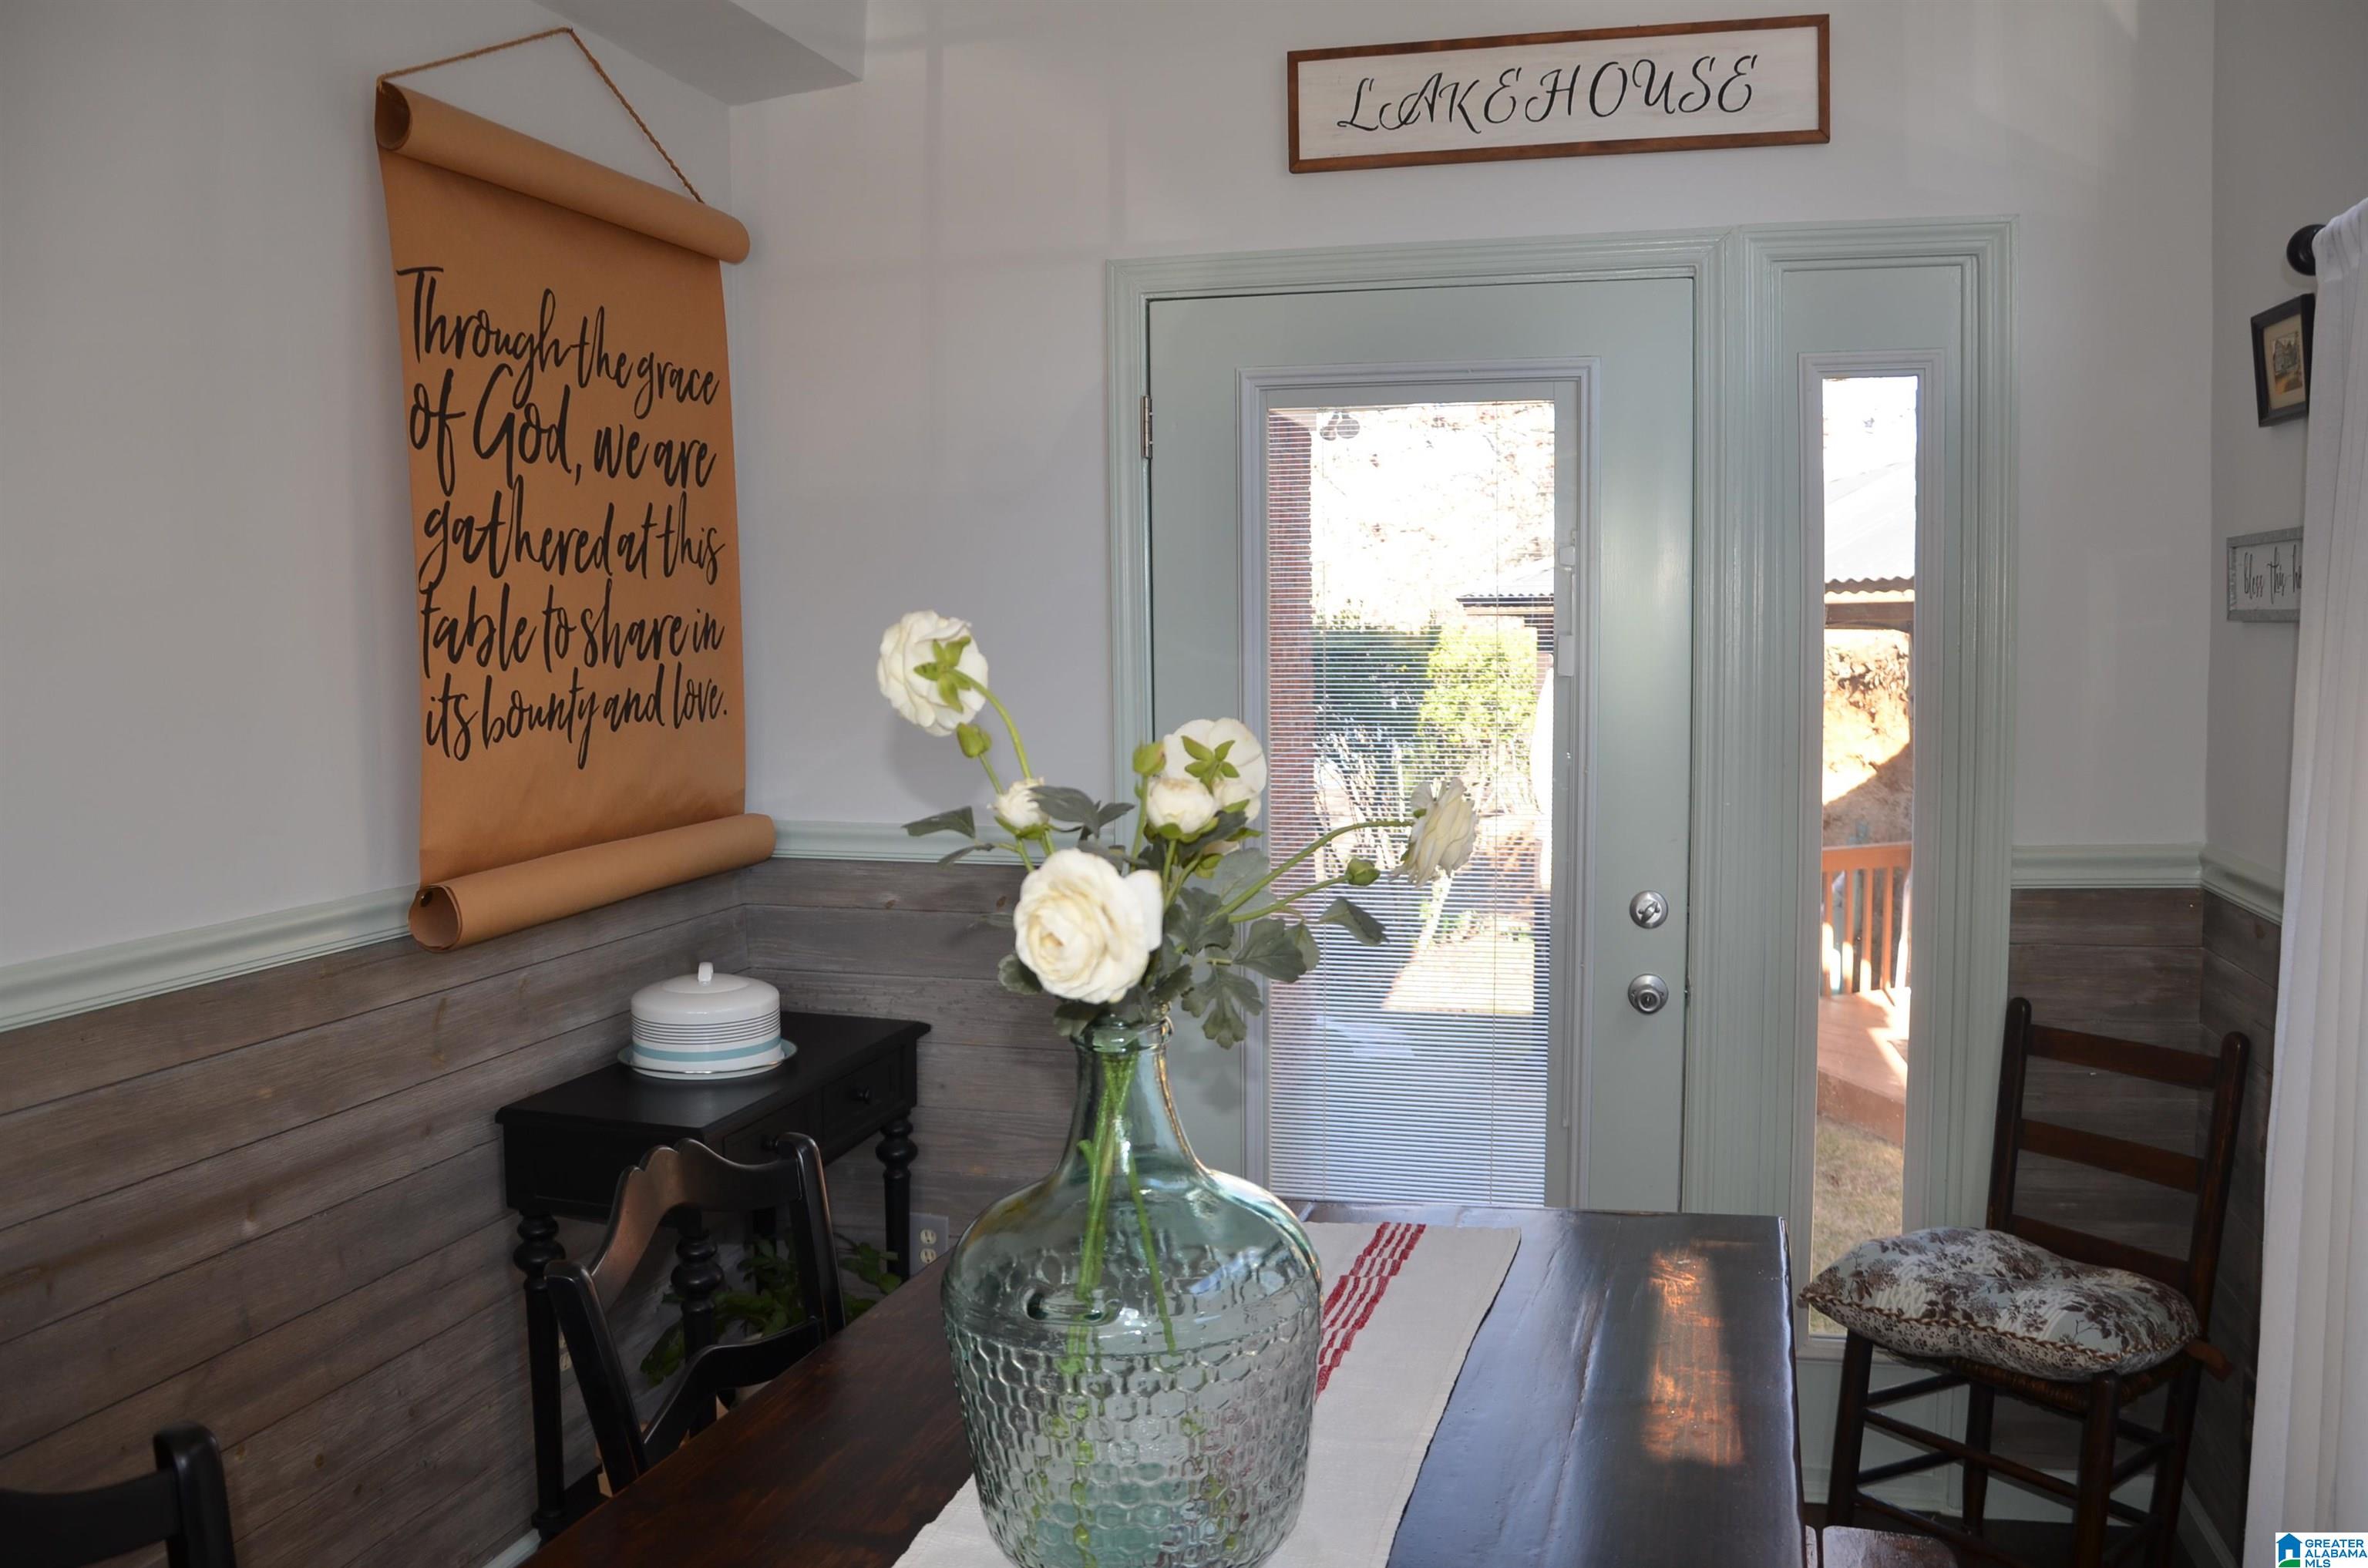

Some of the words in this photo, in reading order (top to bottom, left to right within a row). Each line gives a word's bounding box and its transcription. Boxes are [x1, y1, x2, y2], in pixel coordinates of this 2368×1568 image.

[395, 267, 572, 409] Through
[569, 305, 634, 389] the
[634, 352, 720, 420] grace
[409, 368, 466, 497] of
[473, 363, 582, 490] God,
[594, 423, 649, 479] we
[654, 439, 718, 489] are
[419, 473, 614, 594] gathered
[617, 502, 658, 579] at
[655, 490, 726, 586] this
[421, 581, 537, 679] table
[542, 584, 577, 673] to
[580, 577, 689, 669] share
[694, 608, 725, 654] in
[426, 672, 479, 762] its
[481, 667, 600, 771] bounty
[603, 662, 665, 732] and
[672, 661, 728, 729] love.
